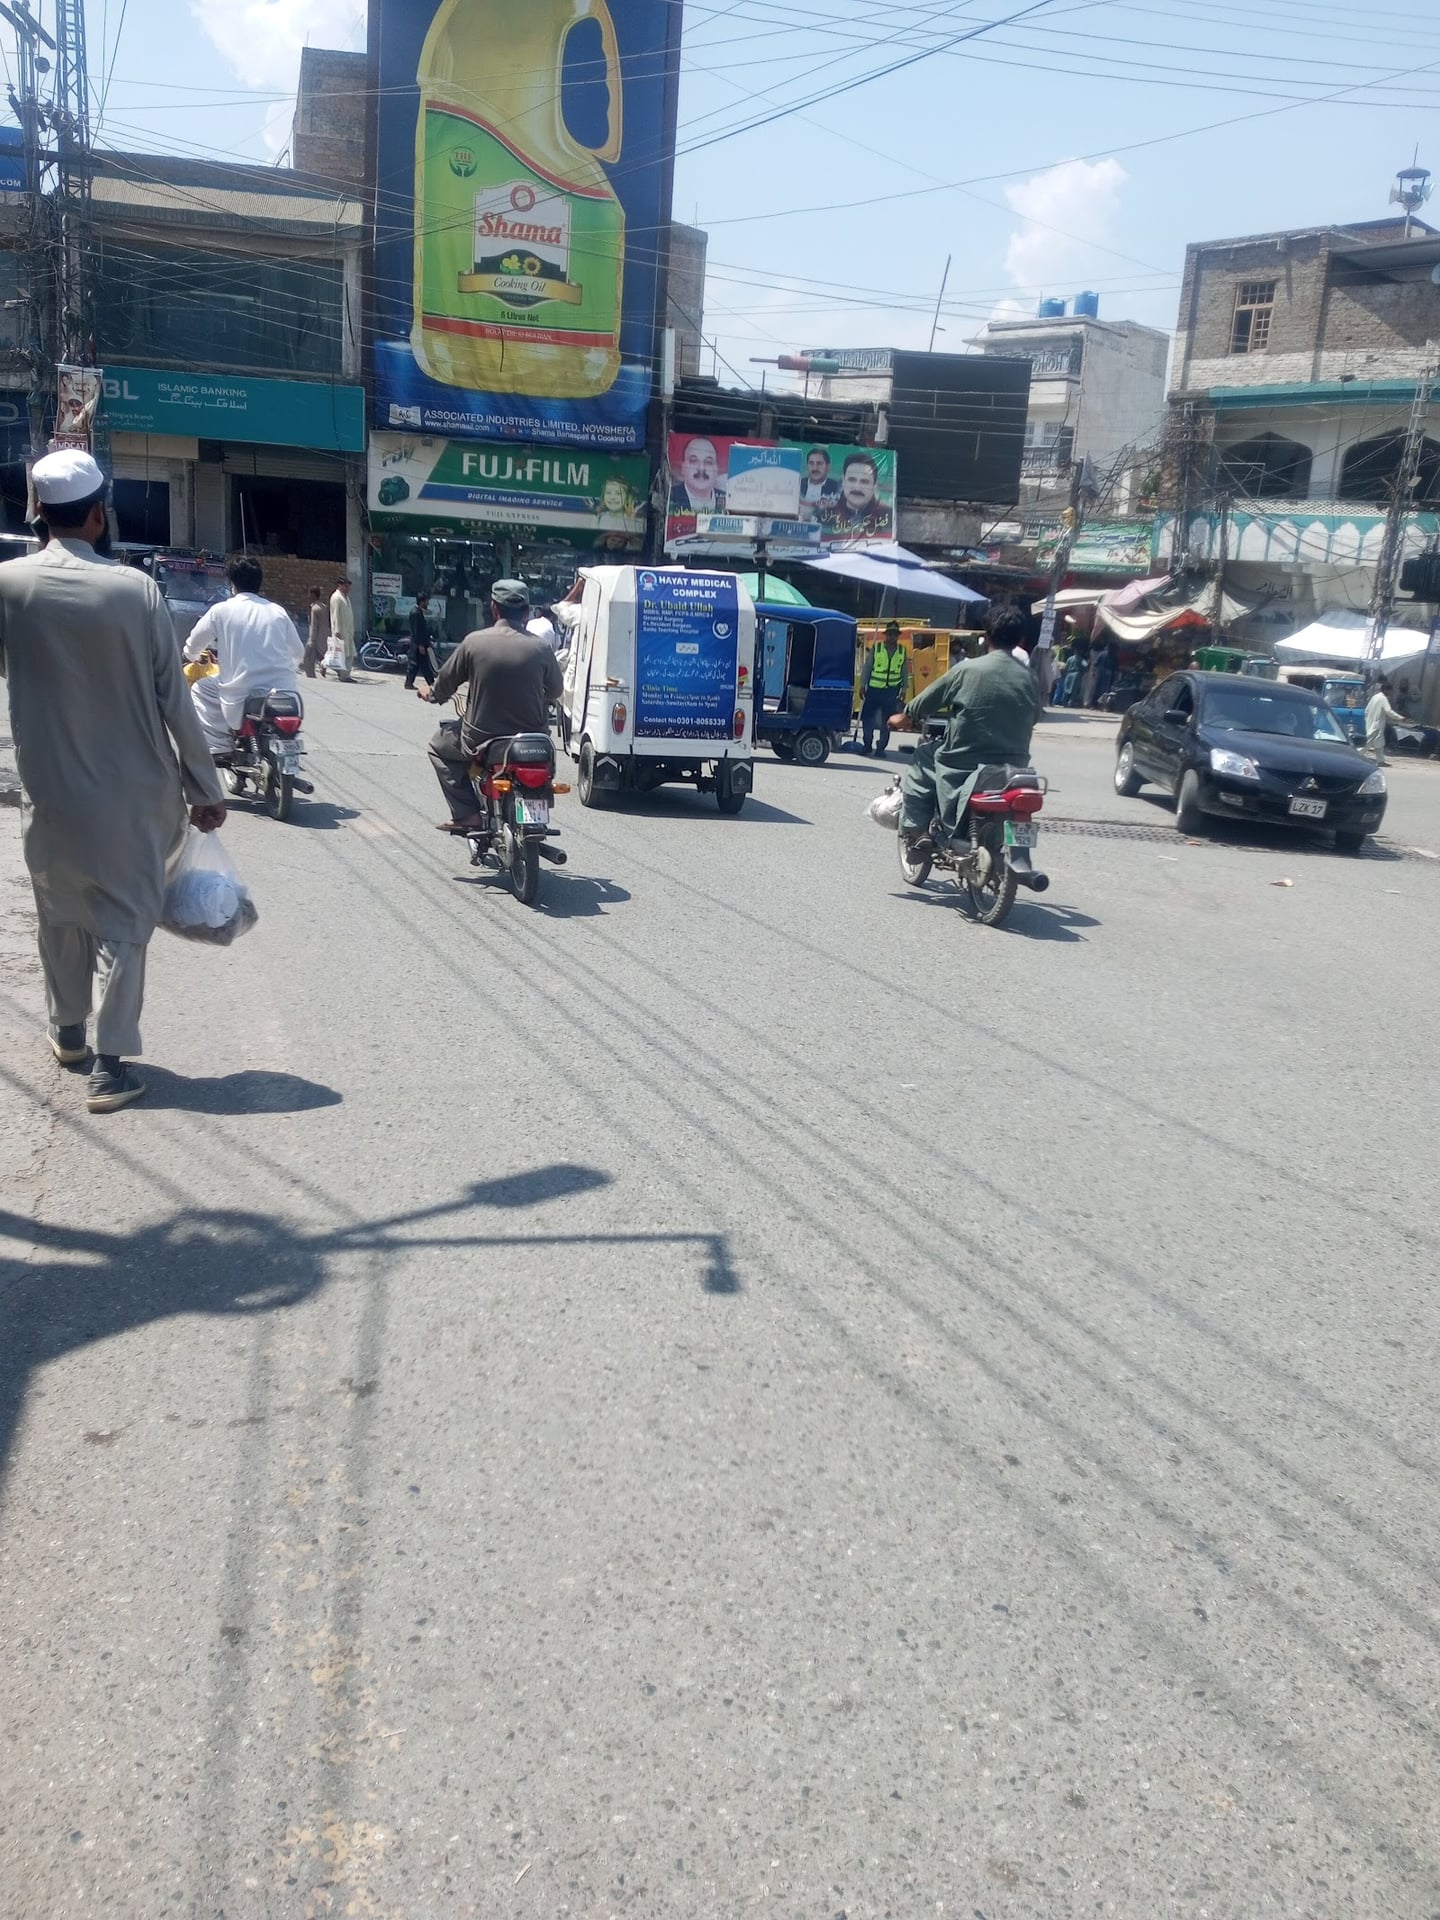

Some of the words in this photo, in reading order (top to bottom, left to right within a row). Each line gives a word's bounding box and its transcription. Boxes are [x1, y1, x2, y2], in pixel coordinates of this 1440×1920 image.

[479, 211, 562, 244] Shama
[493, 277, 528, 292] Cooking
[530, 280, 547, 292] Oil
[158, 383, 198, 394] ISLAMIC
[200, 386, 247, 398] BANKING
[424, 411, 483, 423] ASSOCIATED
[485, 415, 540, 428] INDUSTRIES
[582, 424, 636, 435] NOWSHERA
[531, 428, 556, 437] Shama
[597, 433, 626, 444] Cooking
[467, 492, 496, 502] DIGITAL
[498, 495, 531, 505] IMAGING
[532, 498, 563, 508] SERVICE
[659, 576, 688, 587] HAYAT
[691, 578, 731, 589] MEDICAL
[672, 589, 717, 599] COMPLEX
[644, 600, 657, 609] Dr.
[690, 602, 714, 612] Ullah
